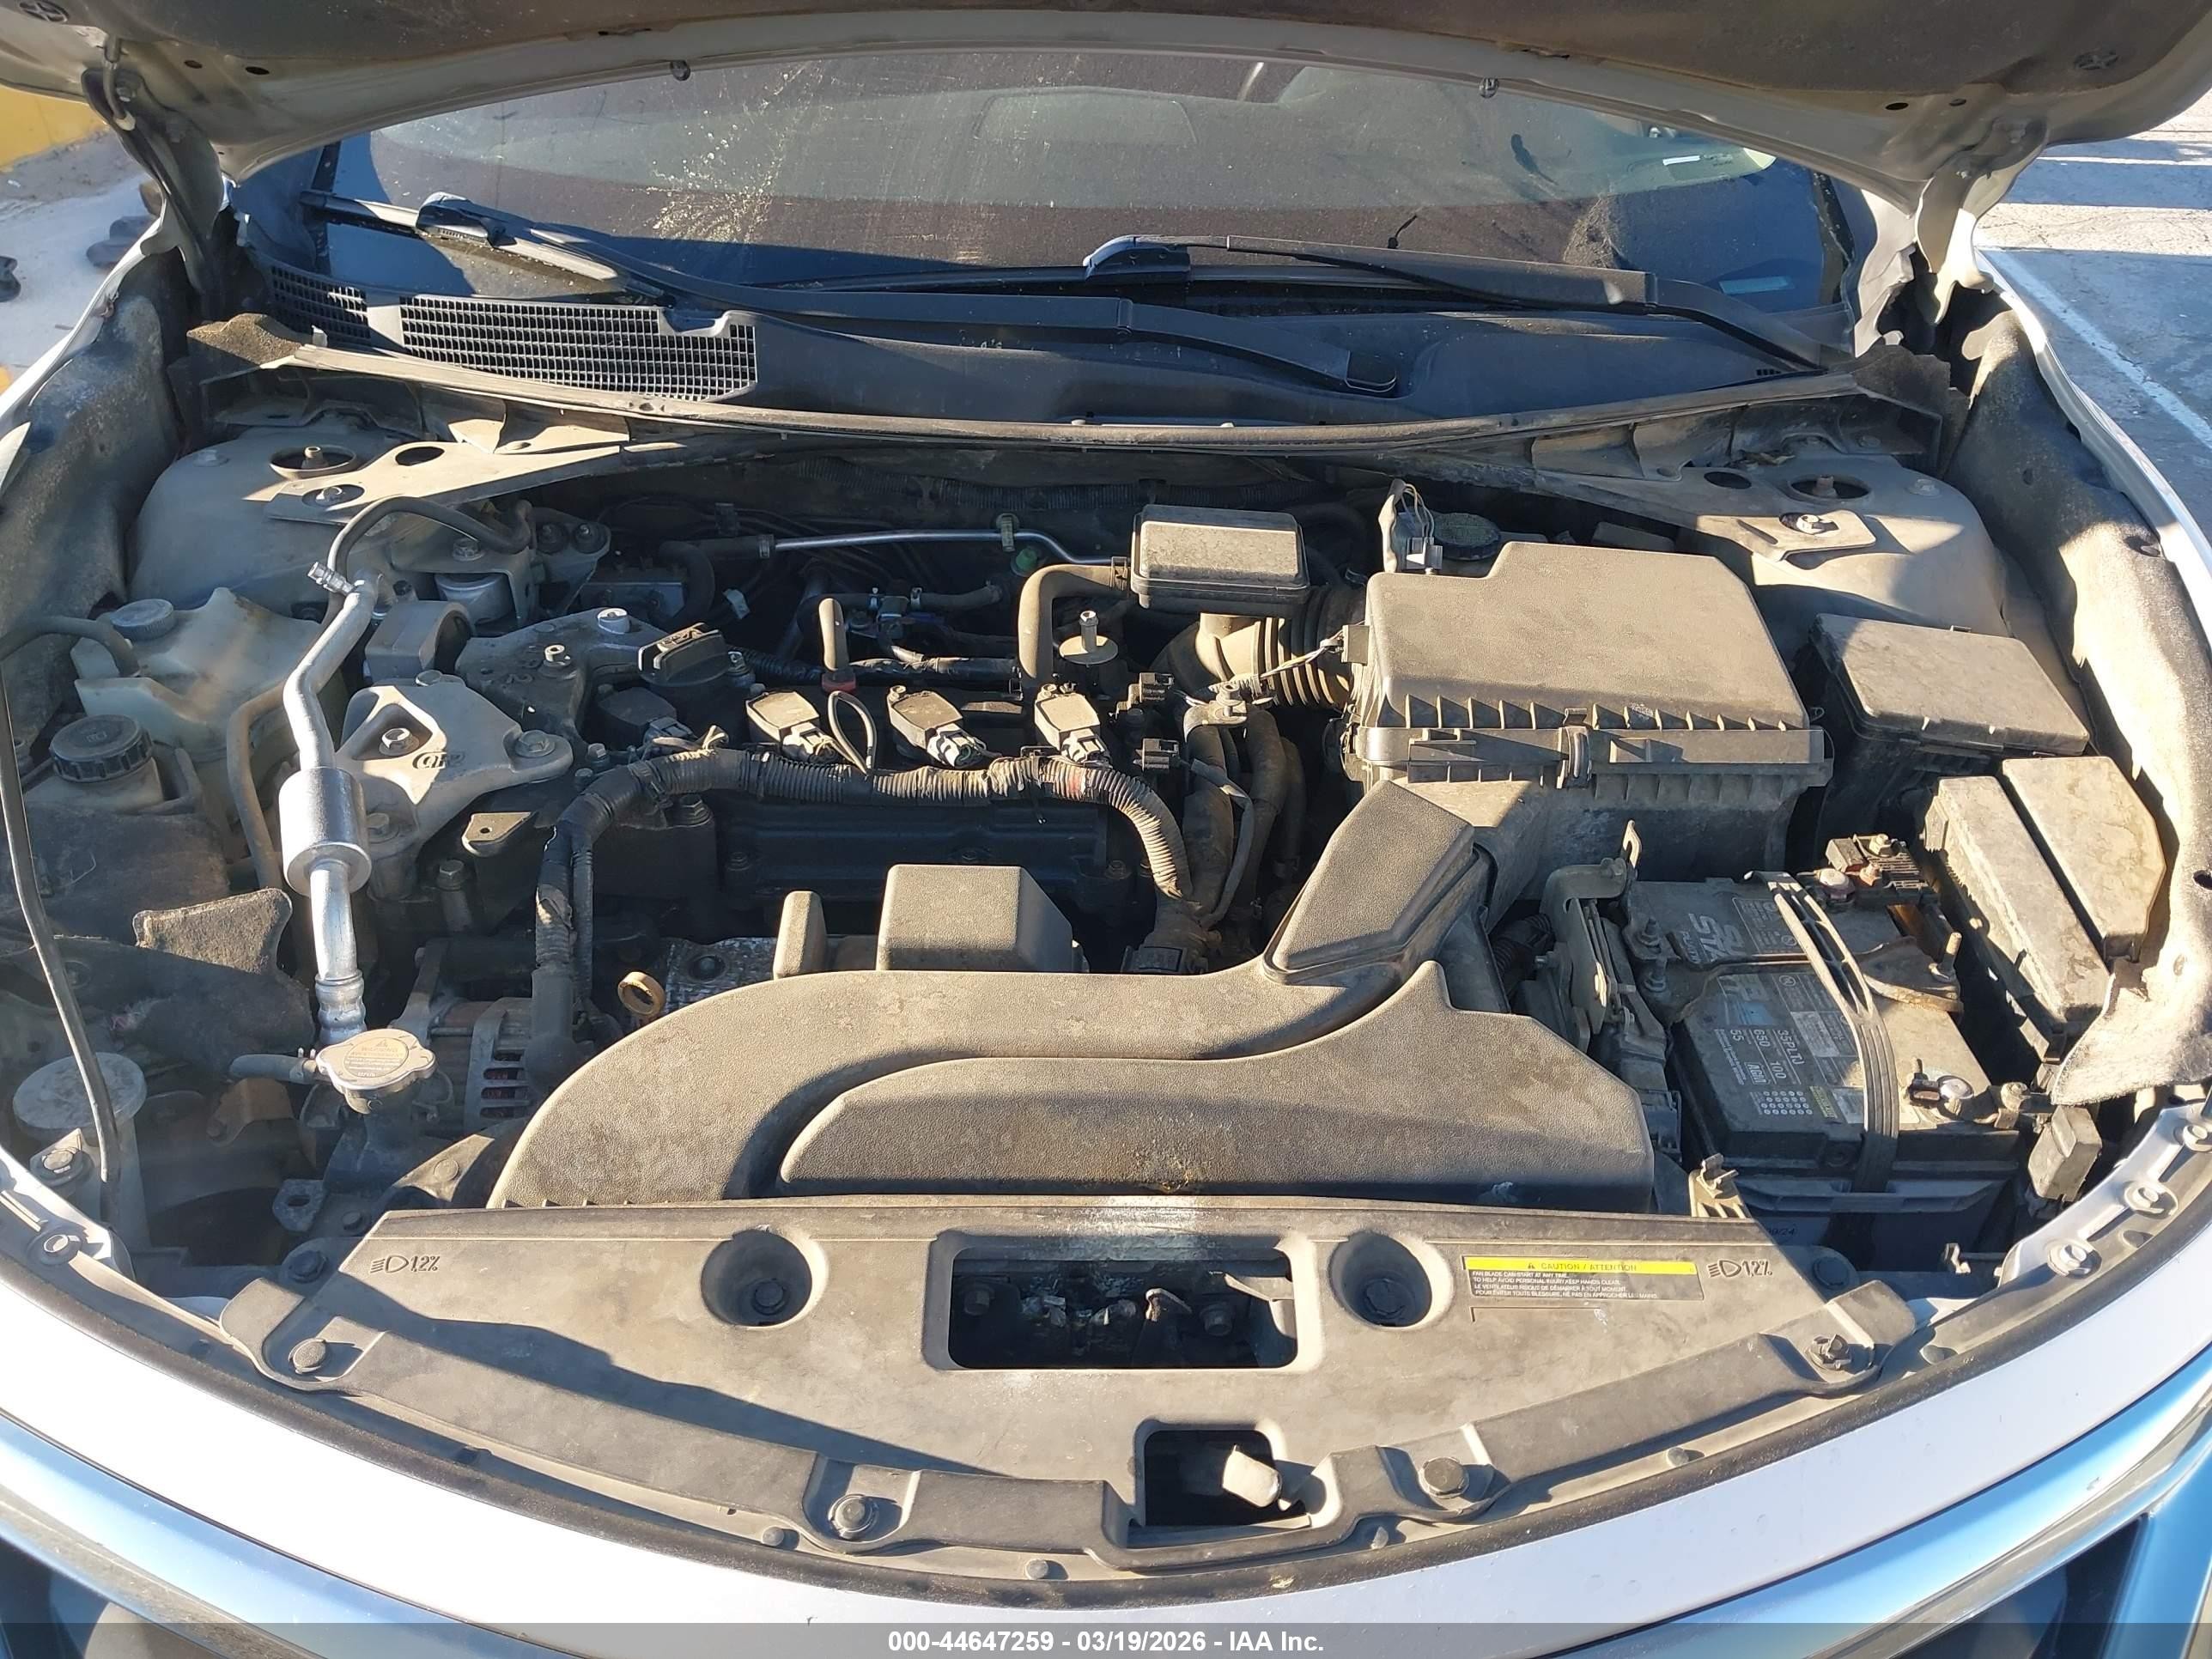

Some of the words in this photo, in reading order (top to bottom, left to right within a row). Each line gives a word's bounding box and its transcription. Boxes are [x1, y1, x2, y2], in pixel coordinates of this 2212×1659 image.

[1730, 1030, 1745, 1042] 55
[1777, 1029, 1805, 1066] 35PLTJ
[1753, 1029, 1771, 1048] 650
[1770, 1061, 1787, 1079] 100
[1747, 1063, 1767, 1084] AGM
